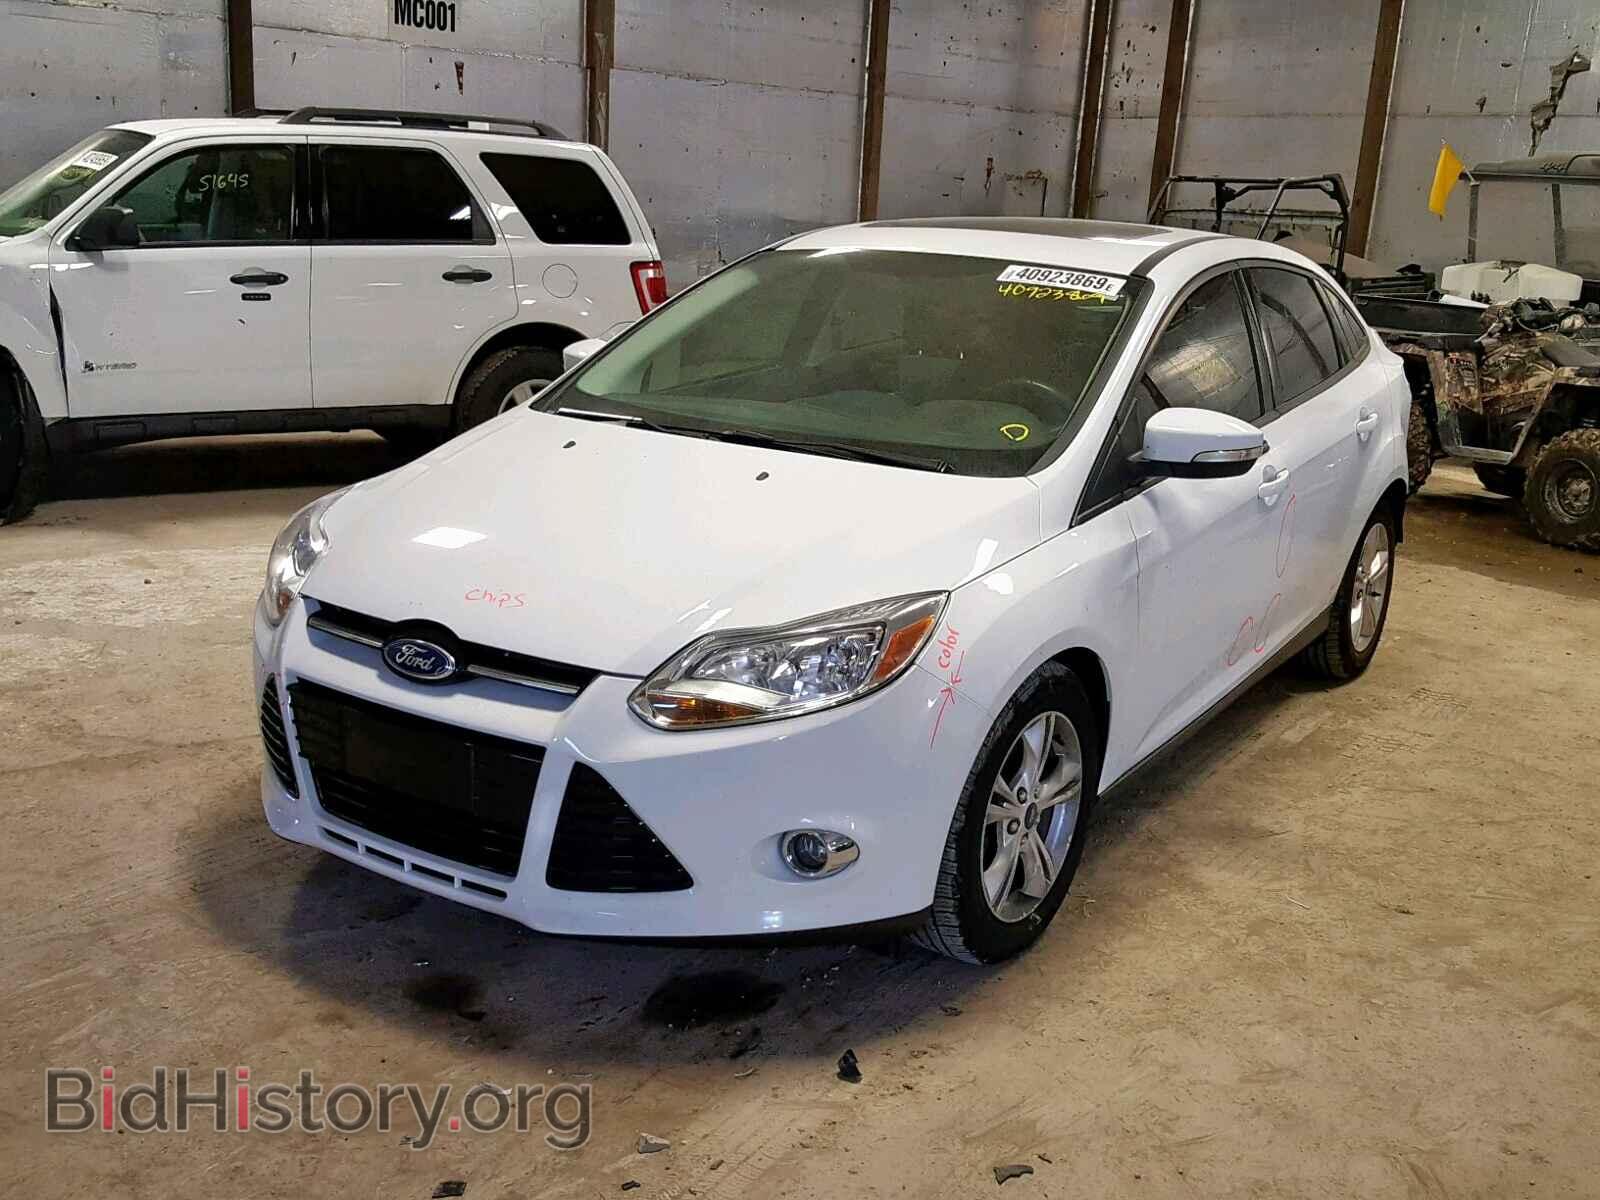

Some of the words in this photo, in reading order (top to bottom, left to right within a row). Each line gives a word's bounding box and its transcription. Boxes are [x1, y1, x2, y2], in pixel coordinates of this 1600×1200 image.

[394, 0, 456, 33] MC001
[1015, 267, 1109, 290] 40923869
[395, 643, 437, 671] Ford
